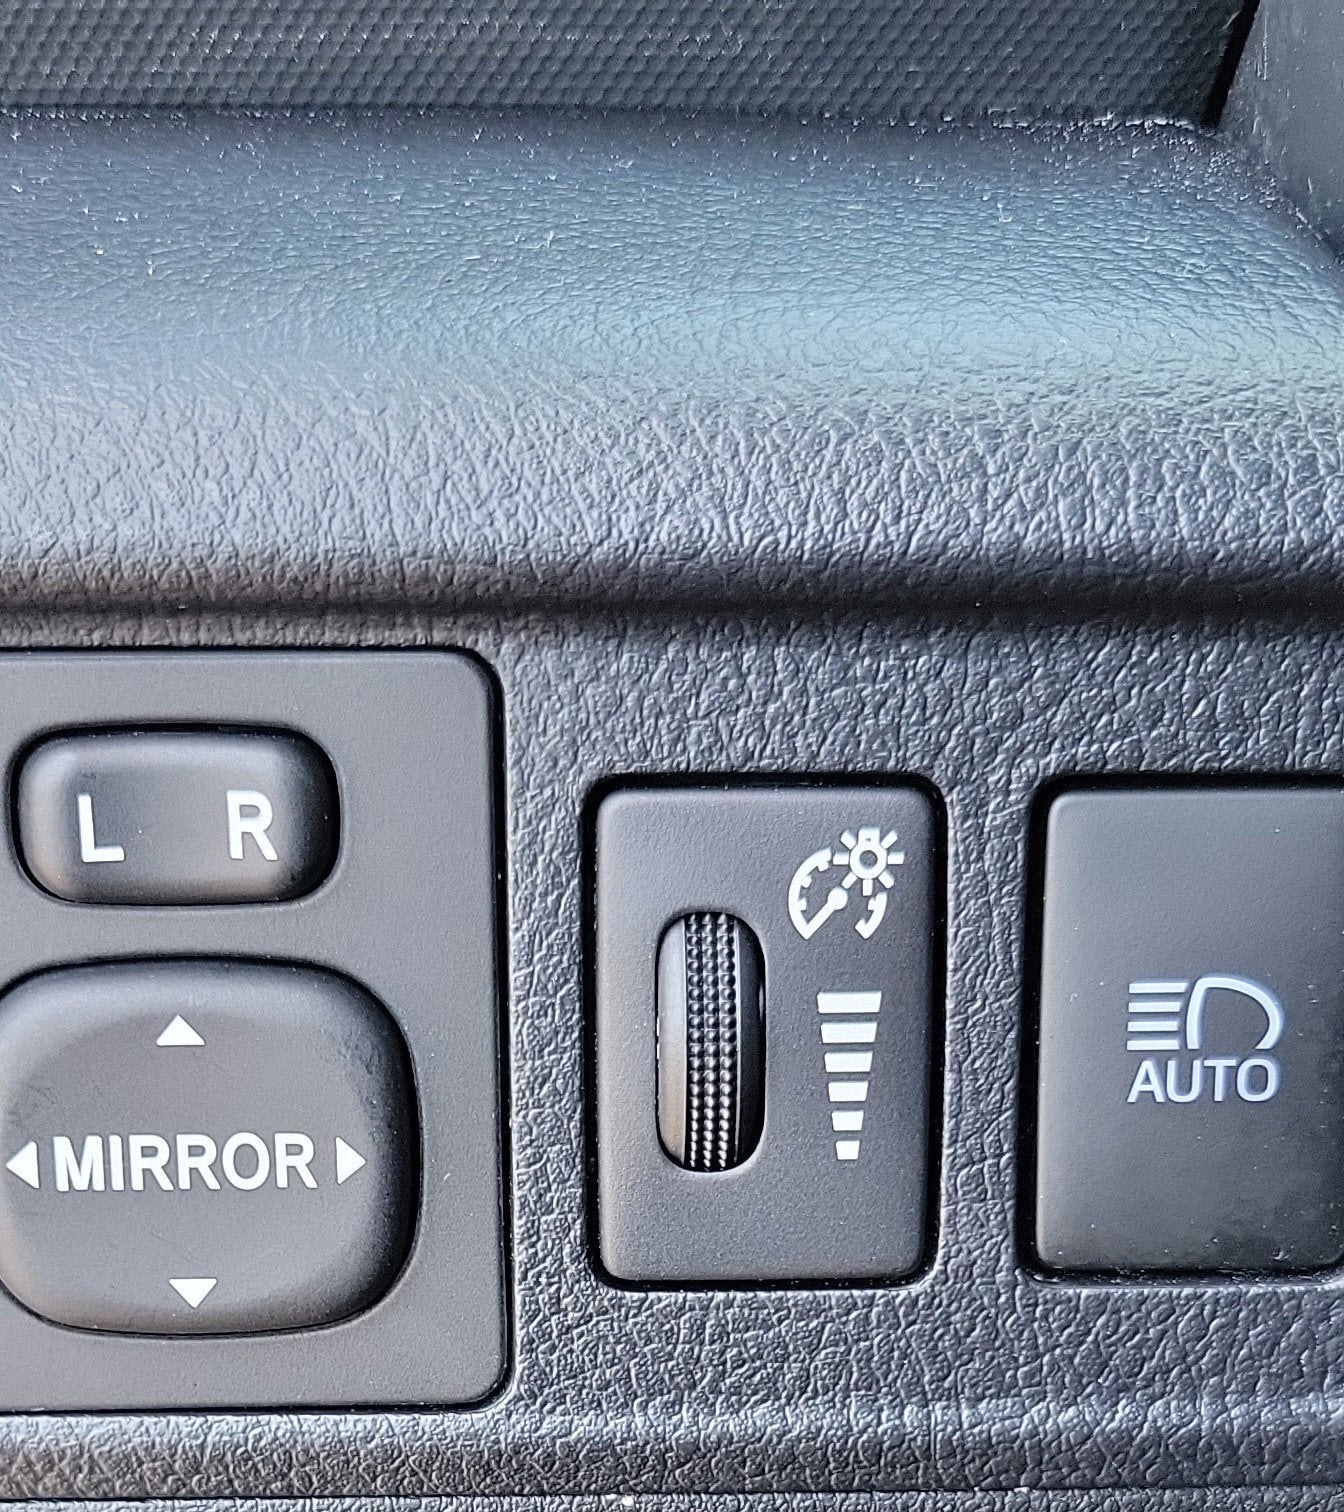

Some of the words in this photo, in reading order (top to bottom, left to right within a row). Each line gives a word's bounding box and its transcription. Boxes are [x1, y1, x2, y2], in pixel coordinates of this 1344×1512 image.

[78, 793, 125, 863] L
[226, 790, 278, 861] R
[1127, 1058, 1279, 1103] AUTO
[54, 1132, 319, 1191] MIRROR
